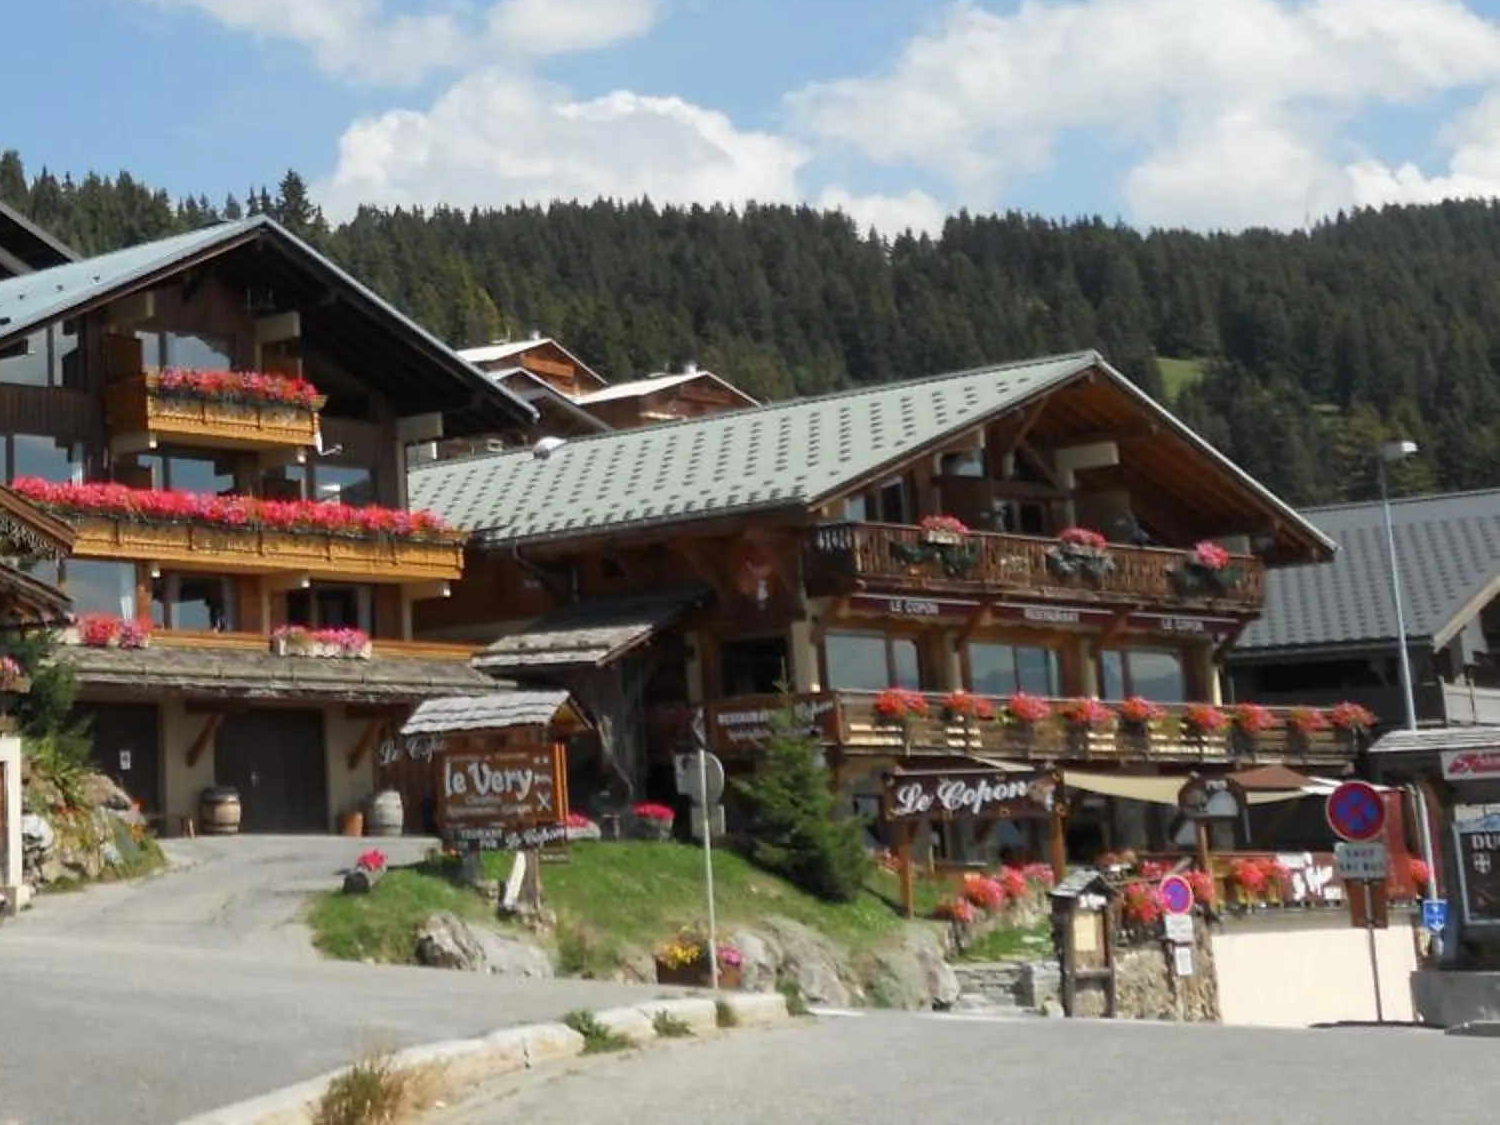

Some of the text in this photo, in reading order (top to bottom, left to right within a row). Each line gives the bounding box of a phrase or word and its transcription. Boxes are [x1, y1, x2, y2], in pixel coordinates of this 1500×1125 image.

[467, 761, 533, 801] Very
[890, 777, 1028, 816] Le Copon
